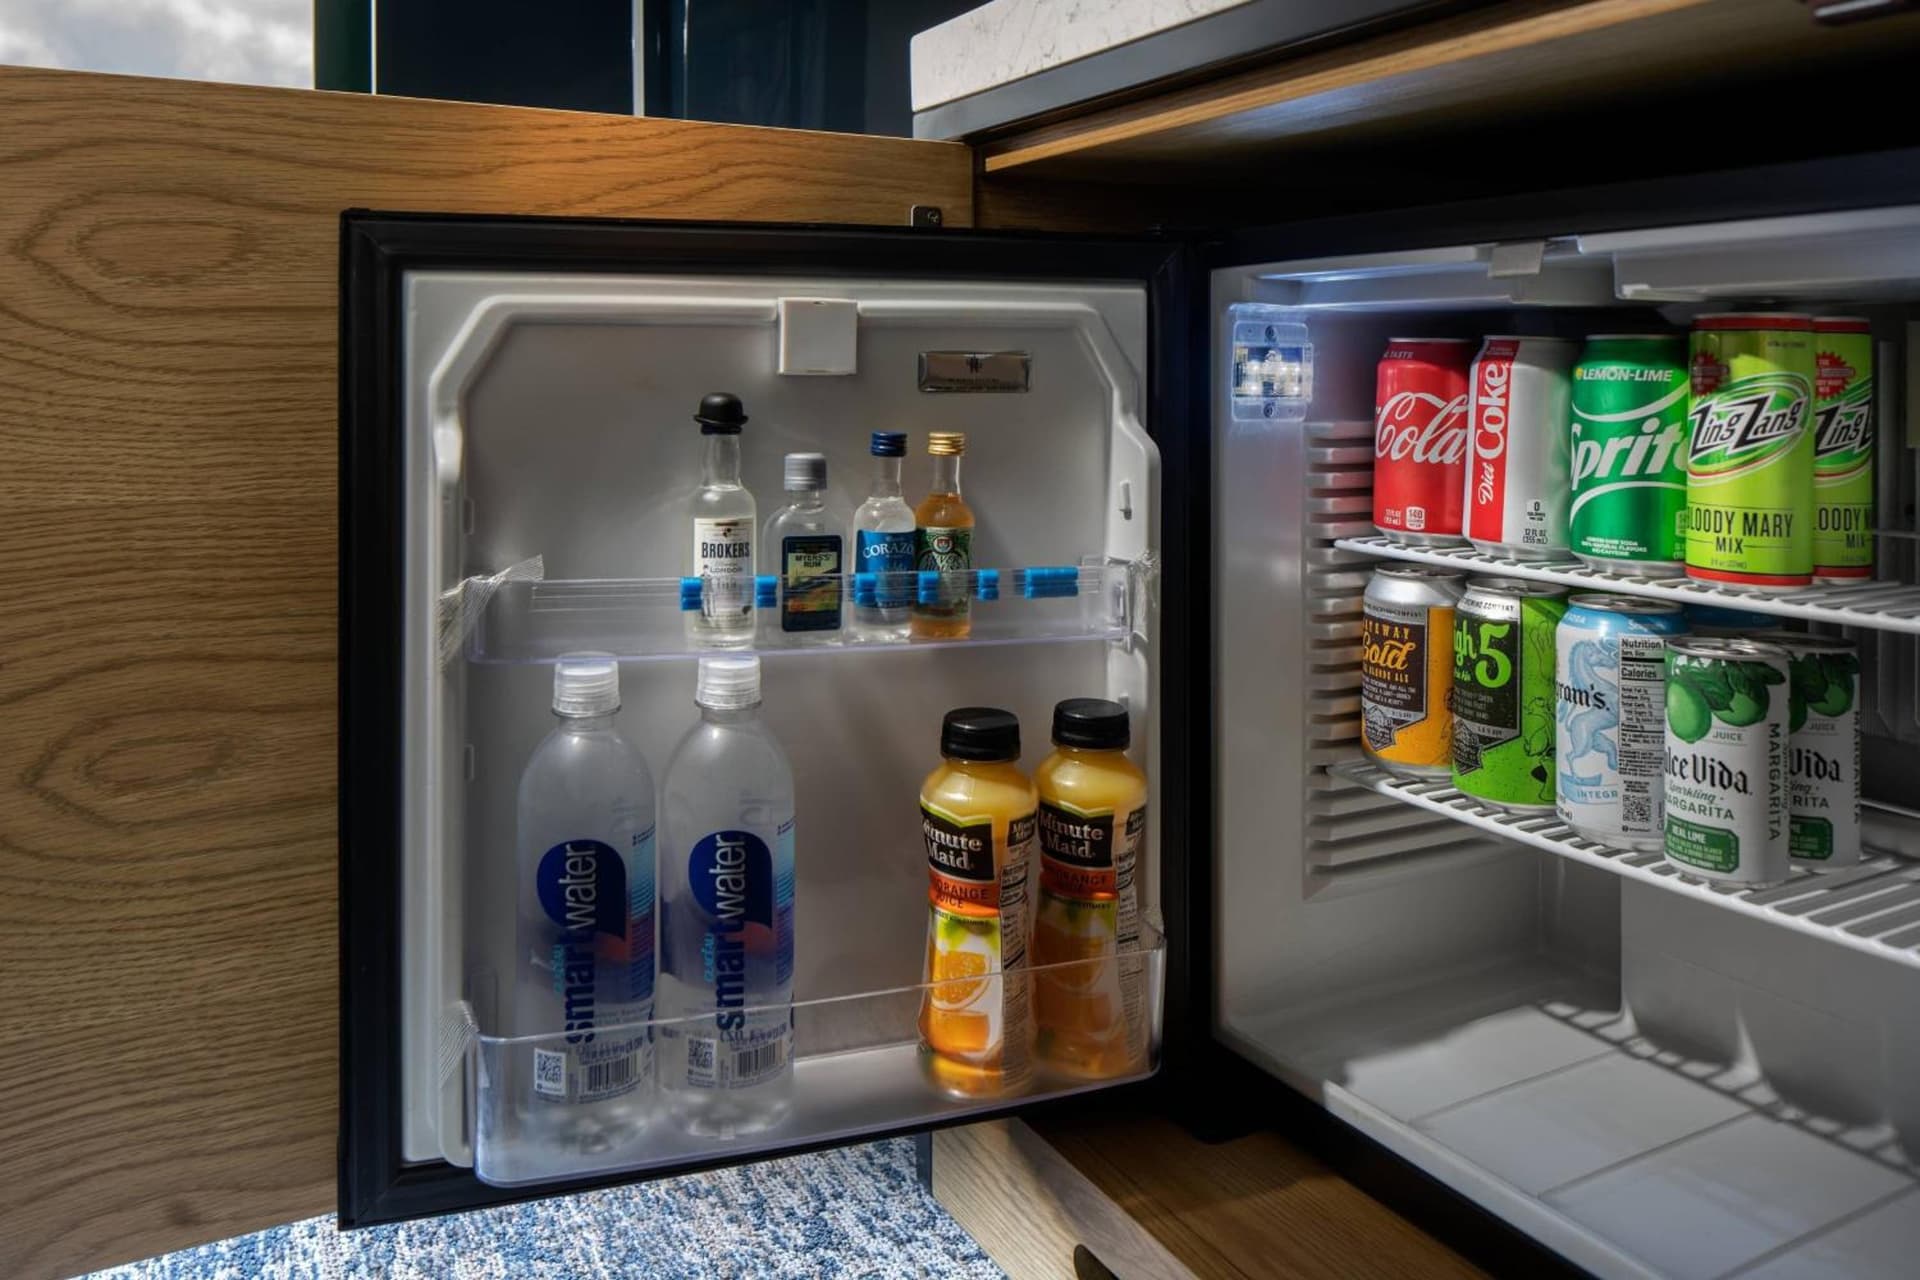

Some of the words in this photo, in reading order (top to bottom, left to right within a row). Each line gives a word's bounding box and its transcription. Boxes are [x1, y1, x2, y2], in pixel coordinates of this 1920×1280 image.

[1582, 367, 1673, 382] LEMON-LIME
[1476, 363, 1509, 459] Coke
[1376, 391, 1469, 464] Cola
[1689, 403, 1745, 459] Zing
[1726, 394, 1803, 450] Zang
[1814, 403, 1864, 457] Zing
[1478, 462, 1495, 505] Diet
[1743, 512, 1793, 538] MARY
[1813, 507, 1862, 532] OODY
[863, 543, 914, 559] CORAZO
[1716, 536, 1744, 554] MIX
[1454, 619, 1477, 667] gh
[1475, 623, 1512, 688] 5
[1621, 638, 1662, 649] Nutrition
[1621, 667, 1657, 678] Calories
[1713, 731, 1743, 742] JUICE
[1692, 753, 1750, 796] Vida
[1769, 723, 1782, 841] MARGARITA
[1047, 829, 1094, 858] Maid
[935, 878, 988, 900] ORANGE
